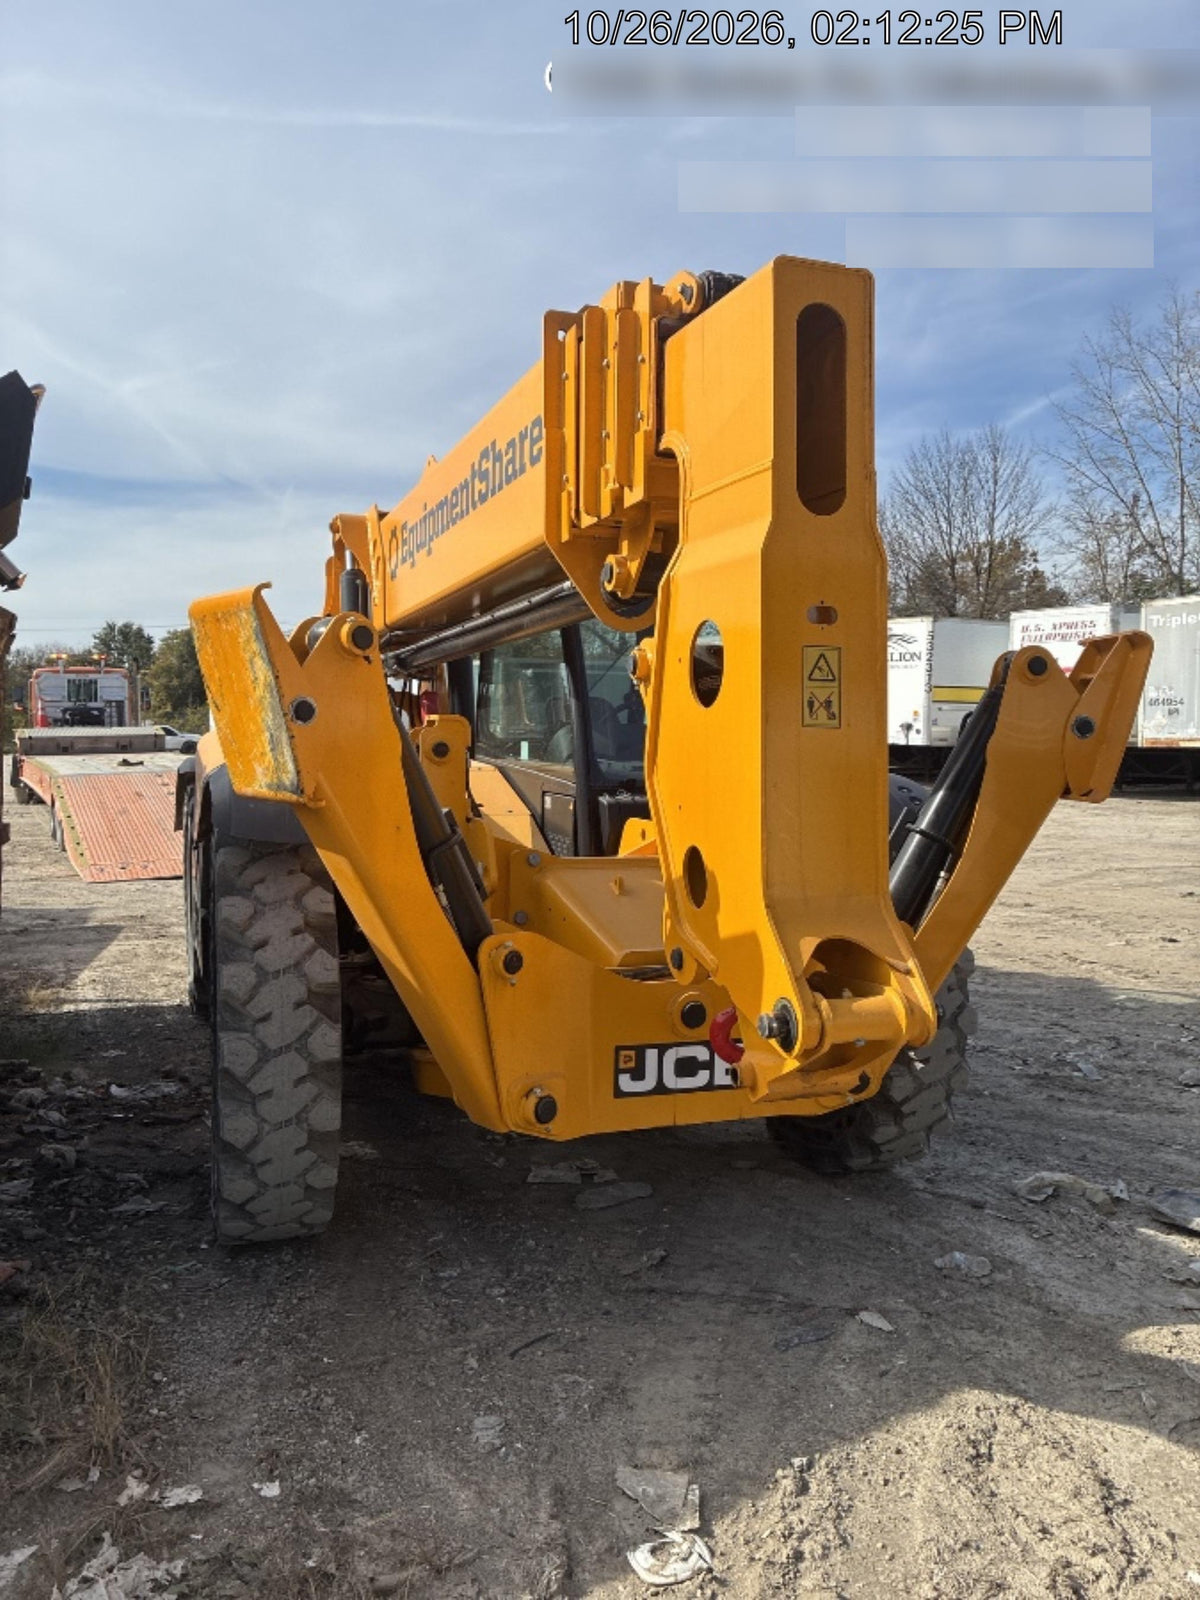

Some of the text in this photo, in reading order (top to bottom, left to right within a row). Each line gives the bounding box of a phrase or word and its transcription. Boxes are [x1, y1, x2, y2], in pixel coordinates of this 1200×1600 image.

[400, 414, 543, 569] EquipmentShare
[1052, 620, 1096, 630] XPRESS
[1148, 613, 1200, 628] Triple
[888, 652, 922, 662] LION
